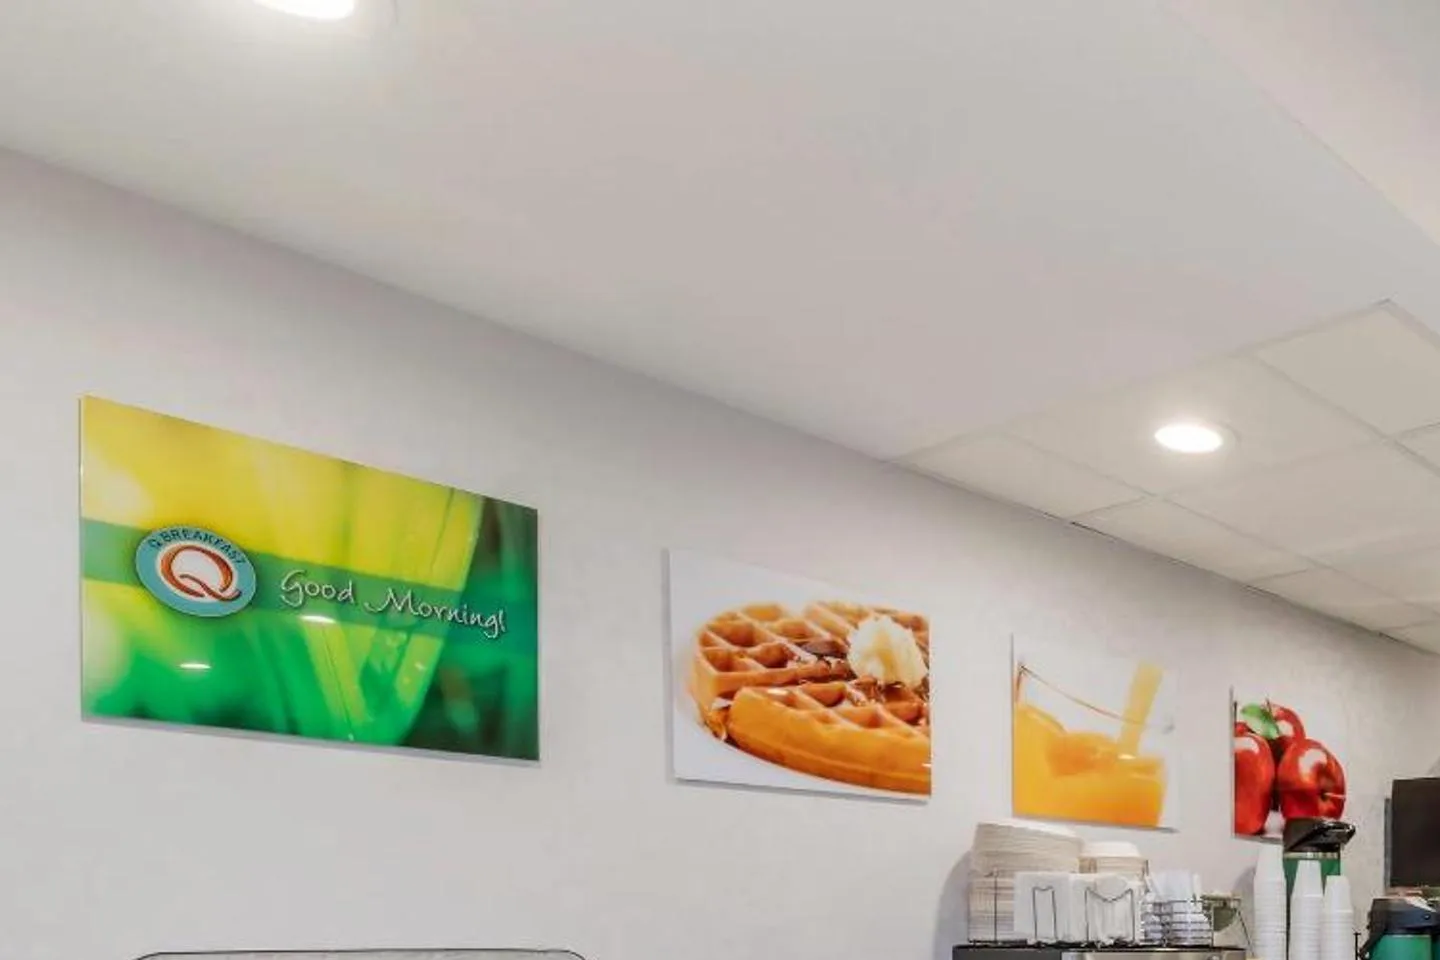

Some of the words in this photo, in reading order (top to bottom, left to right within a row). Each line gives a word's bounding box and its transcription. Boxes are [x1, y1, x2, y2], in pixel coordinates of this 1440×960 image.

[160, 528, 246, 564] BREAKFAST
[160, 544, 242, 602] Q
[279, 569, 355, 608] Good
[364, 586, 506, 639] Morning!
